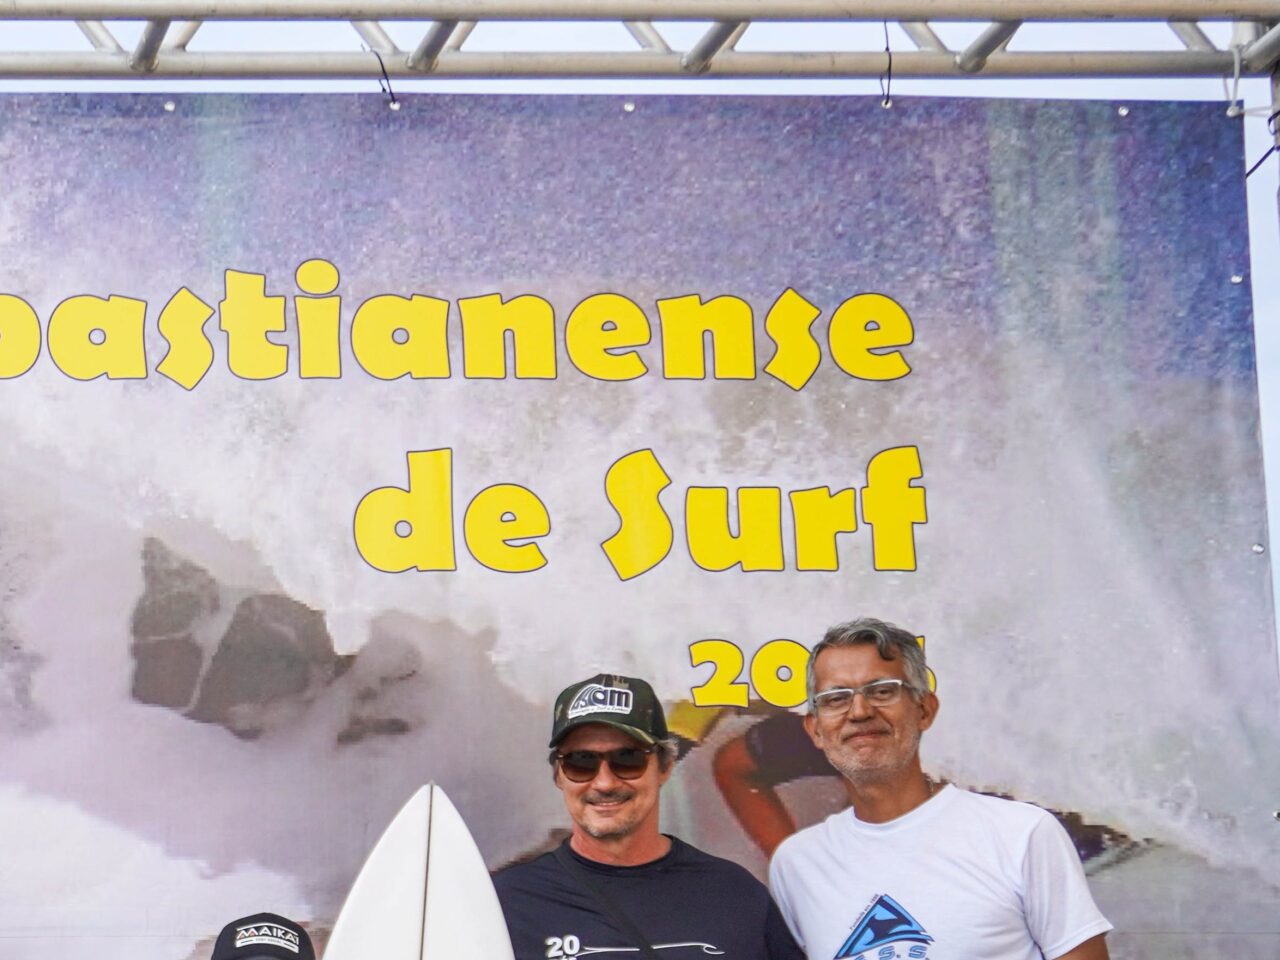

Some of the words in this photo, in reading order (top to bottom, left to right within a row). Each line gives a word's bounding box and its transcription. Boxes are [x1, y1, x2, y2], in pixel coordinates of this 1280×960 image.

[353, 447, 551, 573] de
[600, 445, 927, 581] Surf
[547, 935, 580, 958] 20
